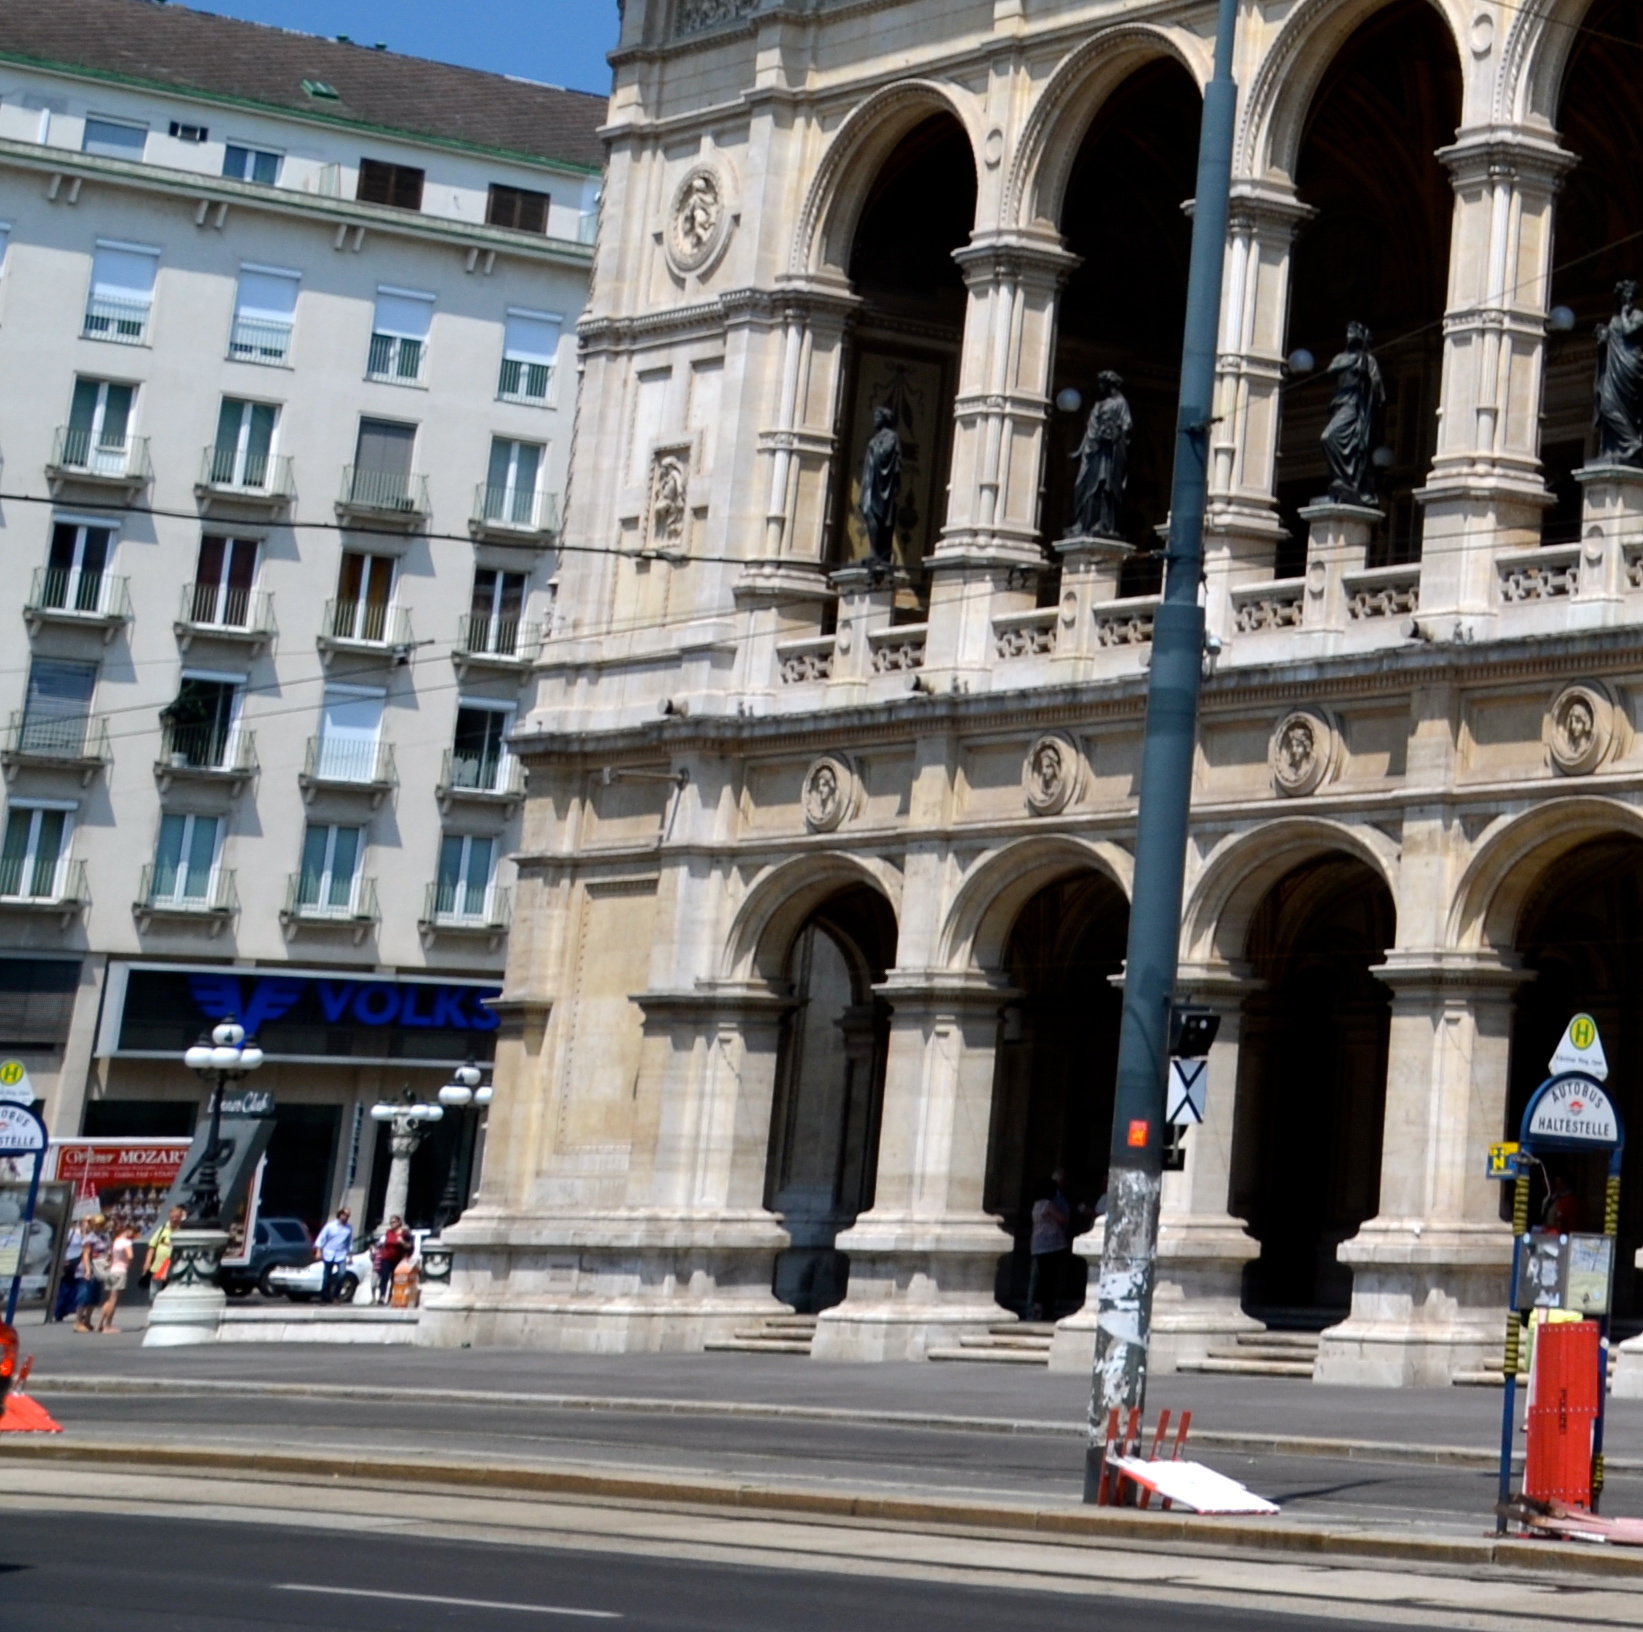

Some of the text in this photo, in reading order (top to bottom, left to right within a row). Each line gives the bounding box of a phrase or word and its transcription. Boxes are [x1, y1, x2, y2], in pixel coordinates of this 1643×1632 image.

[1575, 1022, 1589, 1045] H
[4, 1067, 19, 1081] H
[1550, 1082, 1604, 1109] AUTOBUS
[1538, 1116, 1610, 1137] HALTESTELLE
